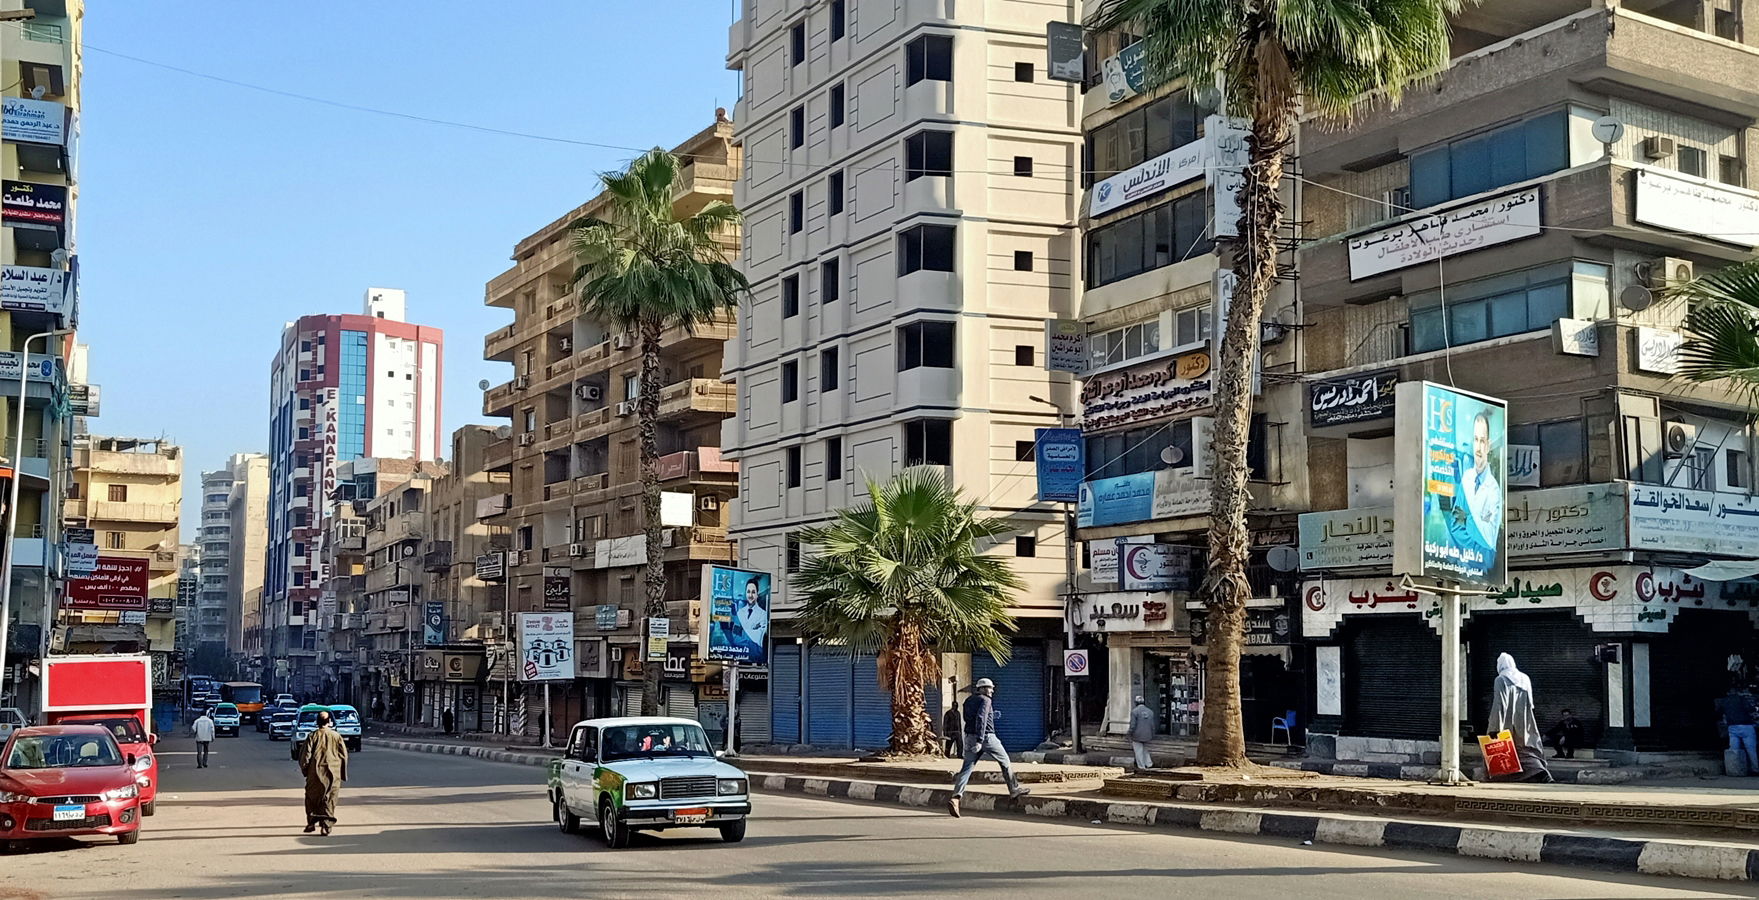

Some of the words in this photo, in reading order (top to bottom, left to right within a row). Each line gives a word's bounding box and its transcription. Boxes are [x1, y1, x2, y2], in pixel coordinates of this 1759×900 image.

[20, 120, 41, 128] الرحمن
[3, 194, 34, 207] طلعت
[36, 198, 61, 209] محمد
[1499, 193, 1536, 213] دكتور
[1451, 205, 1489, 223] محمد
[1351, 229, 1404, 250] برغوت
[1, 268, 28, 281] السلام
[31, 271, 47, 285] عبد
[1181, 355, 1205, 376] دكتور
[1344, 377, 1378, 406] أحمد
[1133, 488, 1150, 497] محمد
[1633, 488, 1685, 513] الخوالقة
[1686, 497, 1709, 511] سعد
[1545, 504, 1589, 522] دكتور
[1321, 515, 1378, 543] النجار
[1544, 528, 1565, 538] التجميل
[1566, 526, 1583, 535] جراحة
[1550, 538, 1577, 548] جراحة
[1093, 548, 1111, 558] مسلم
[1460, 547, 1475, 563] خليل
[1349, 581, 1419, 609] يثرب
[1487, 576, 1562, 604] صيدلية
[1657, 574, 1704, 603] يثرب
[1089, 602, 1139, 627] سعيد
